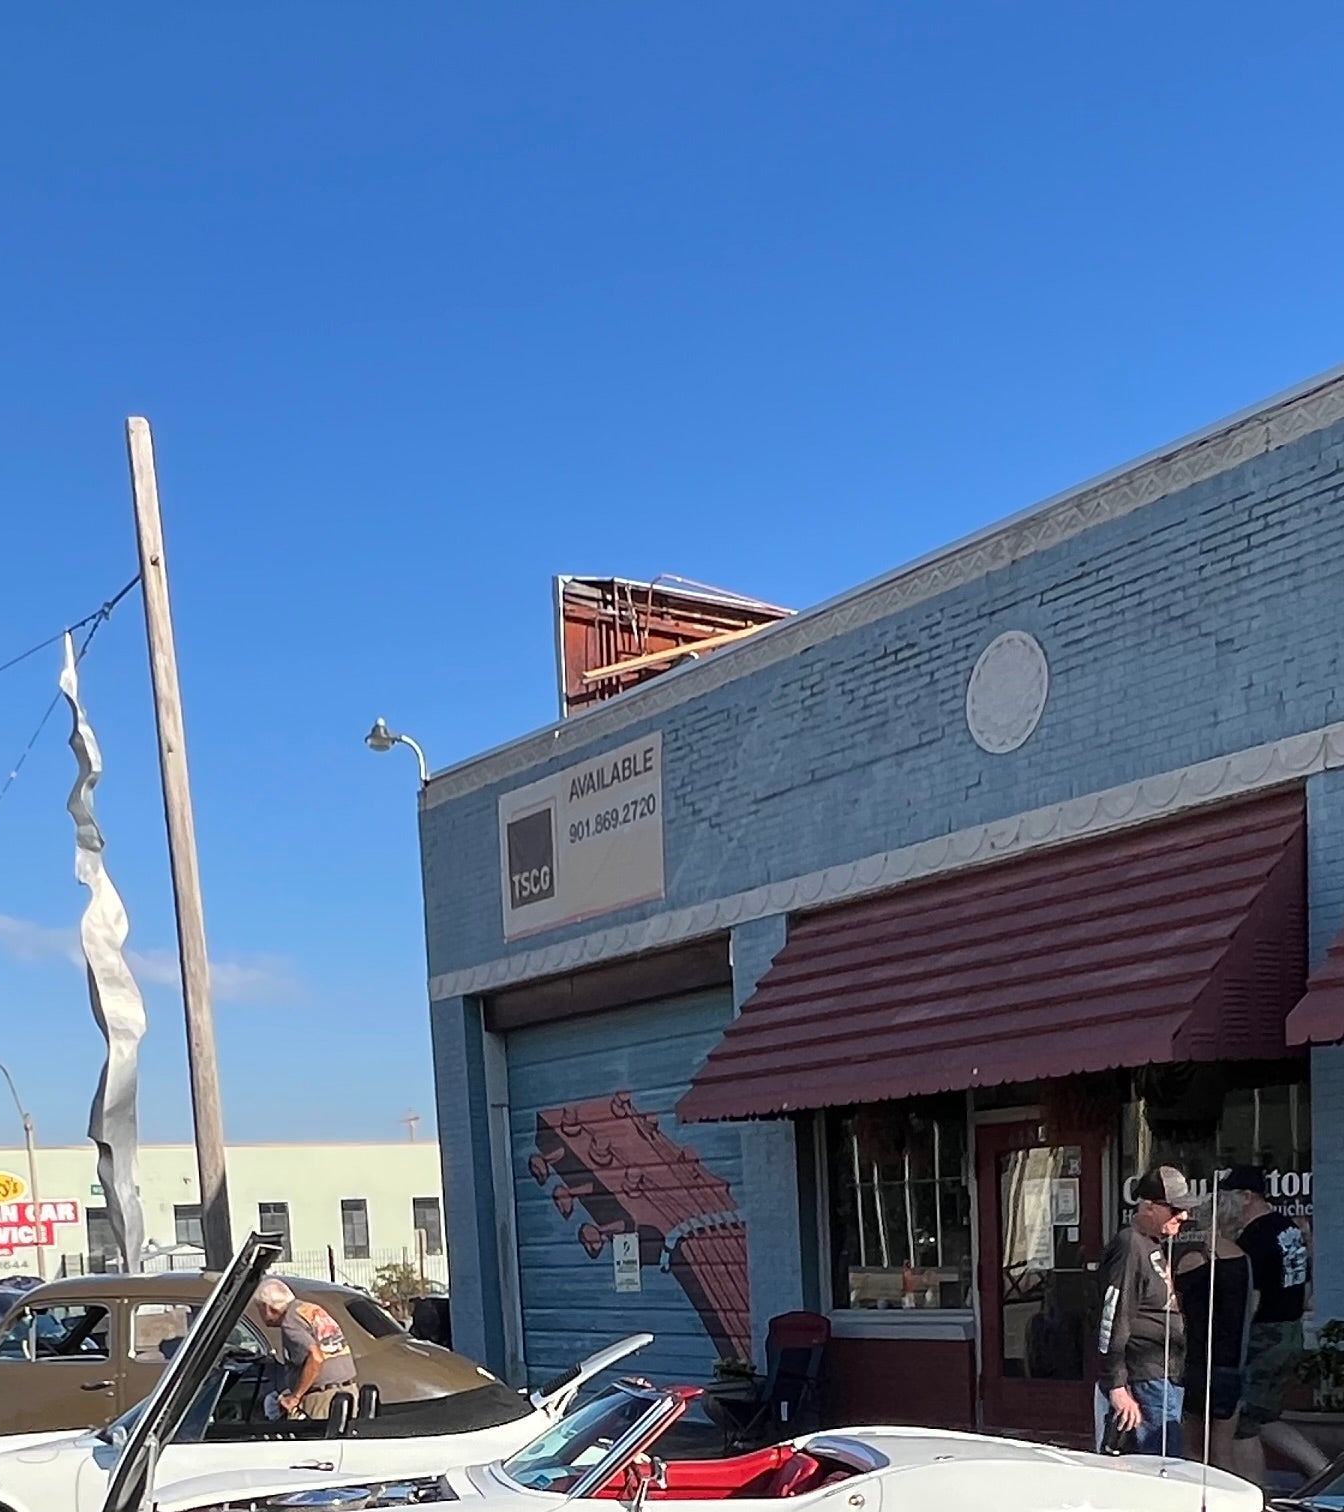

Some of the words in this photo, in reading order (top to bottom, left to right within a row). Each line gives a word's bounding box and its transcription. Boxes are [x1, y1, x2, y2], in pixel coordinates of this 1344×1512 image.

[568, 747, 654, 803] AVAILABLE
[568, 793, 657, 845] 901.869.2720
[512, 866, 551, 899] TSCG
[26, 1202, 76, 1223] CAR
